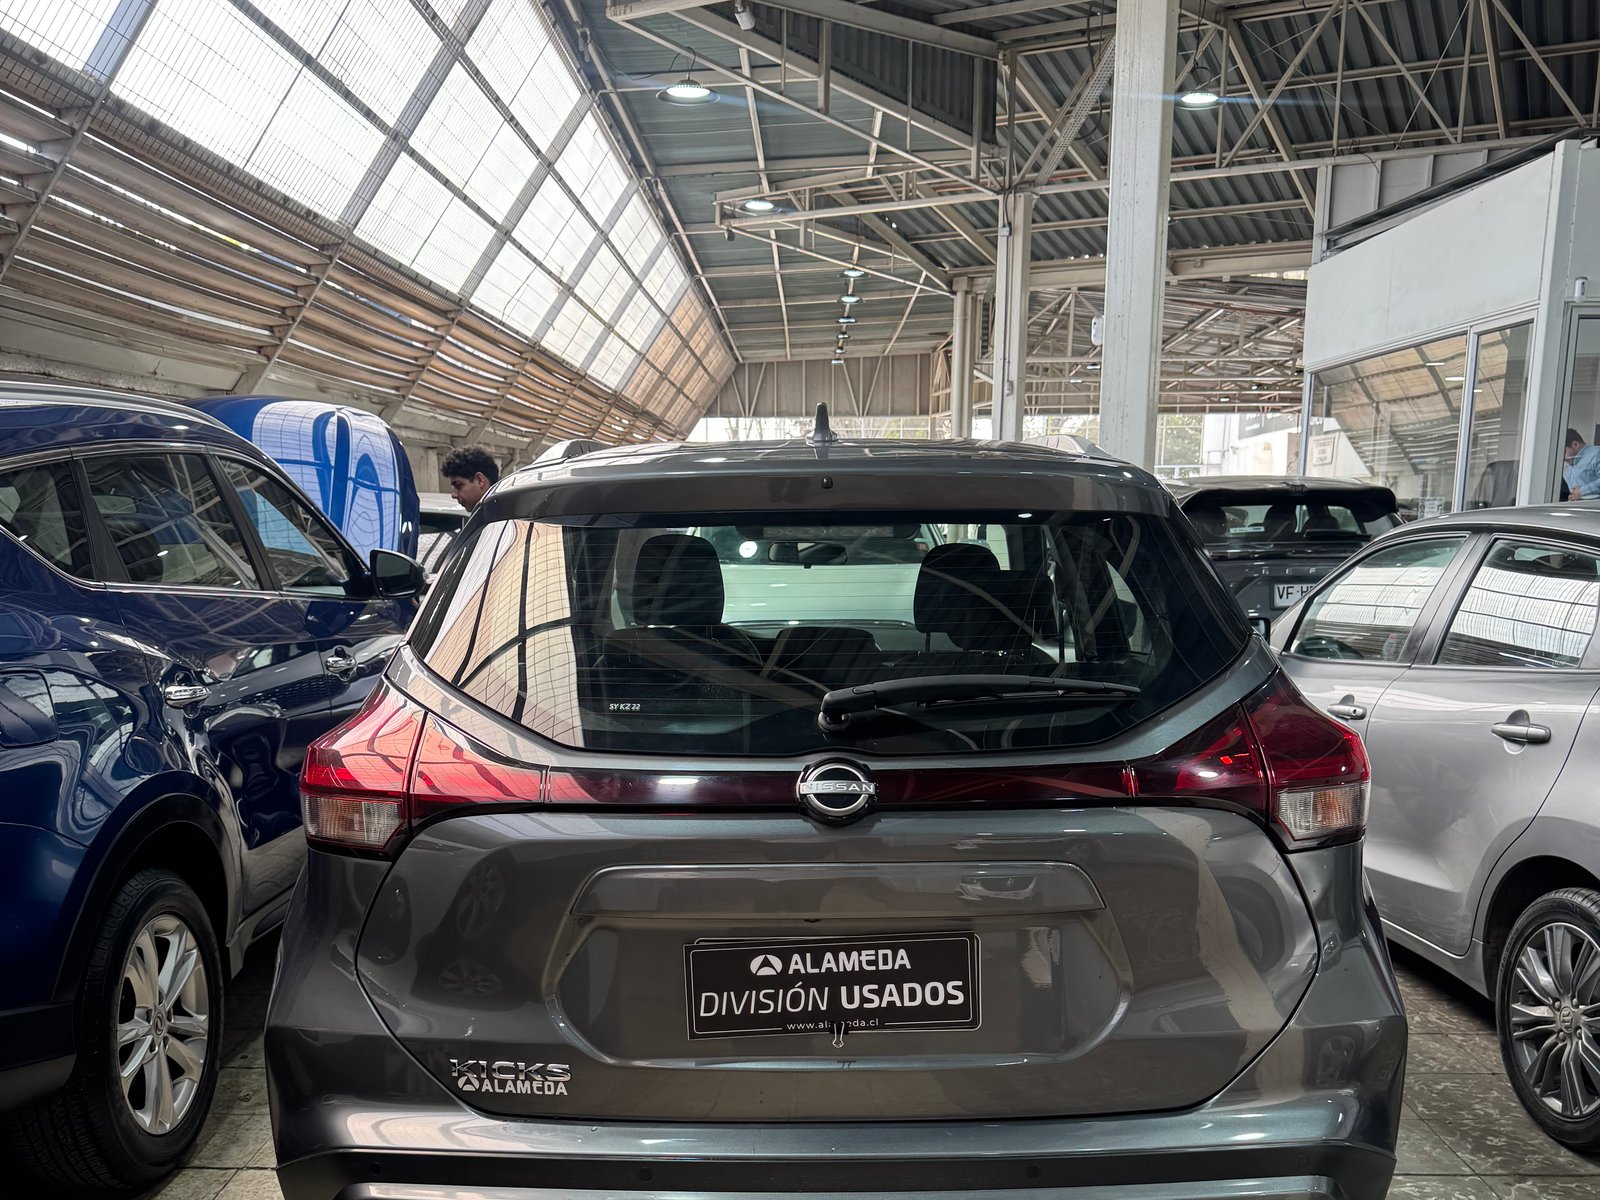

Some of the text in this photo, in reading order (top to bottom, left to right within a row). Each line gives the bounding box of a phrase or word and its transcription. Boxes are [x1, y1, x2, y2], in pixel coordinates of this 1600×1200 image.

[802, 782, 873, 792] NISSAN
[788, 948, 911, 974] ALAMEDA
[700, 980, 965, 1017] DIVISIÓN USADOS
[450, 1059, 571, 1082] KICKS
[481, 1078, 568, 1096] ALAMEDA
